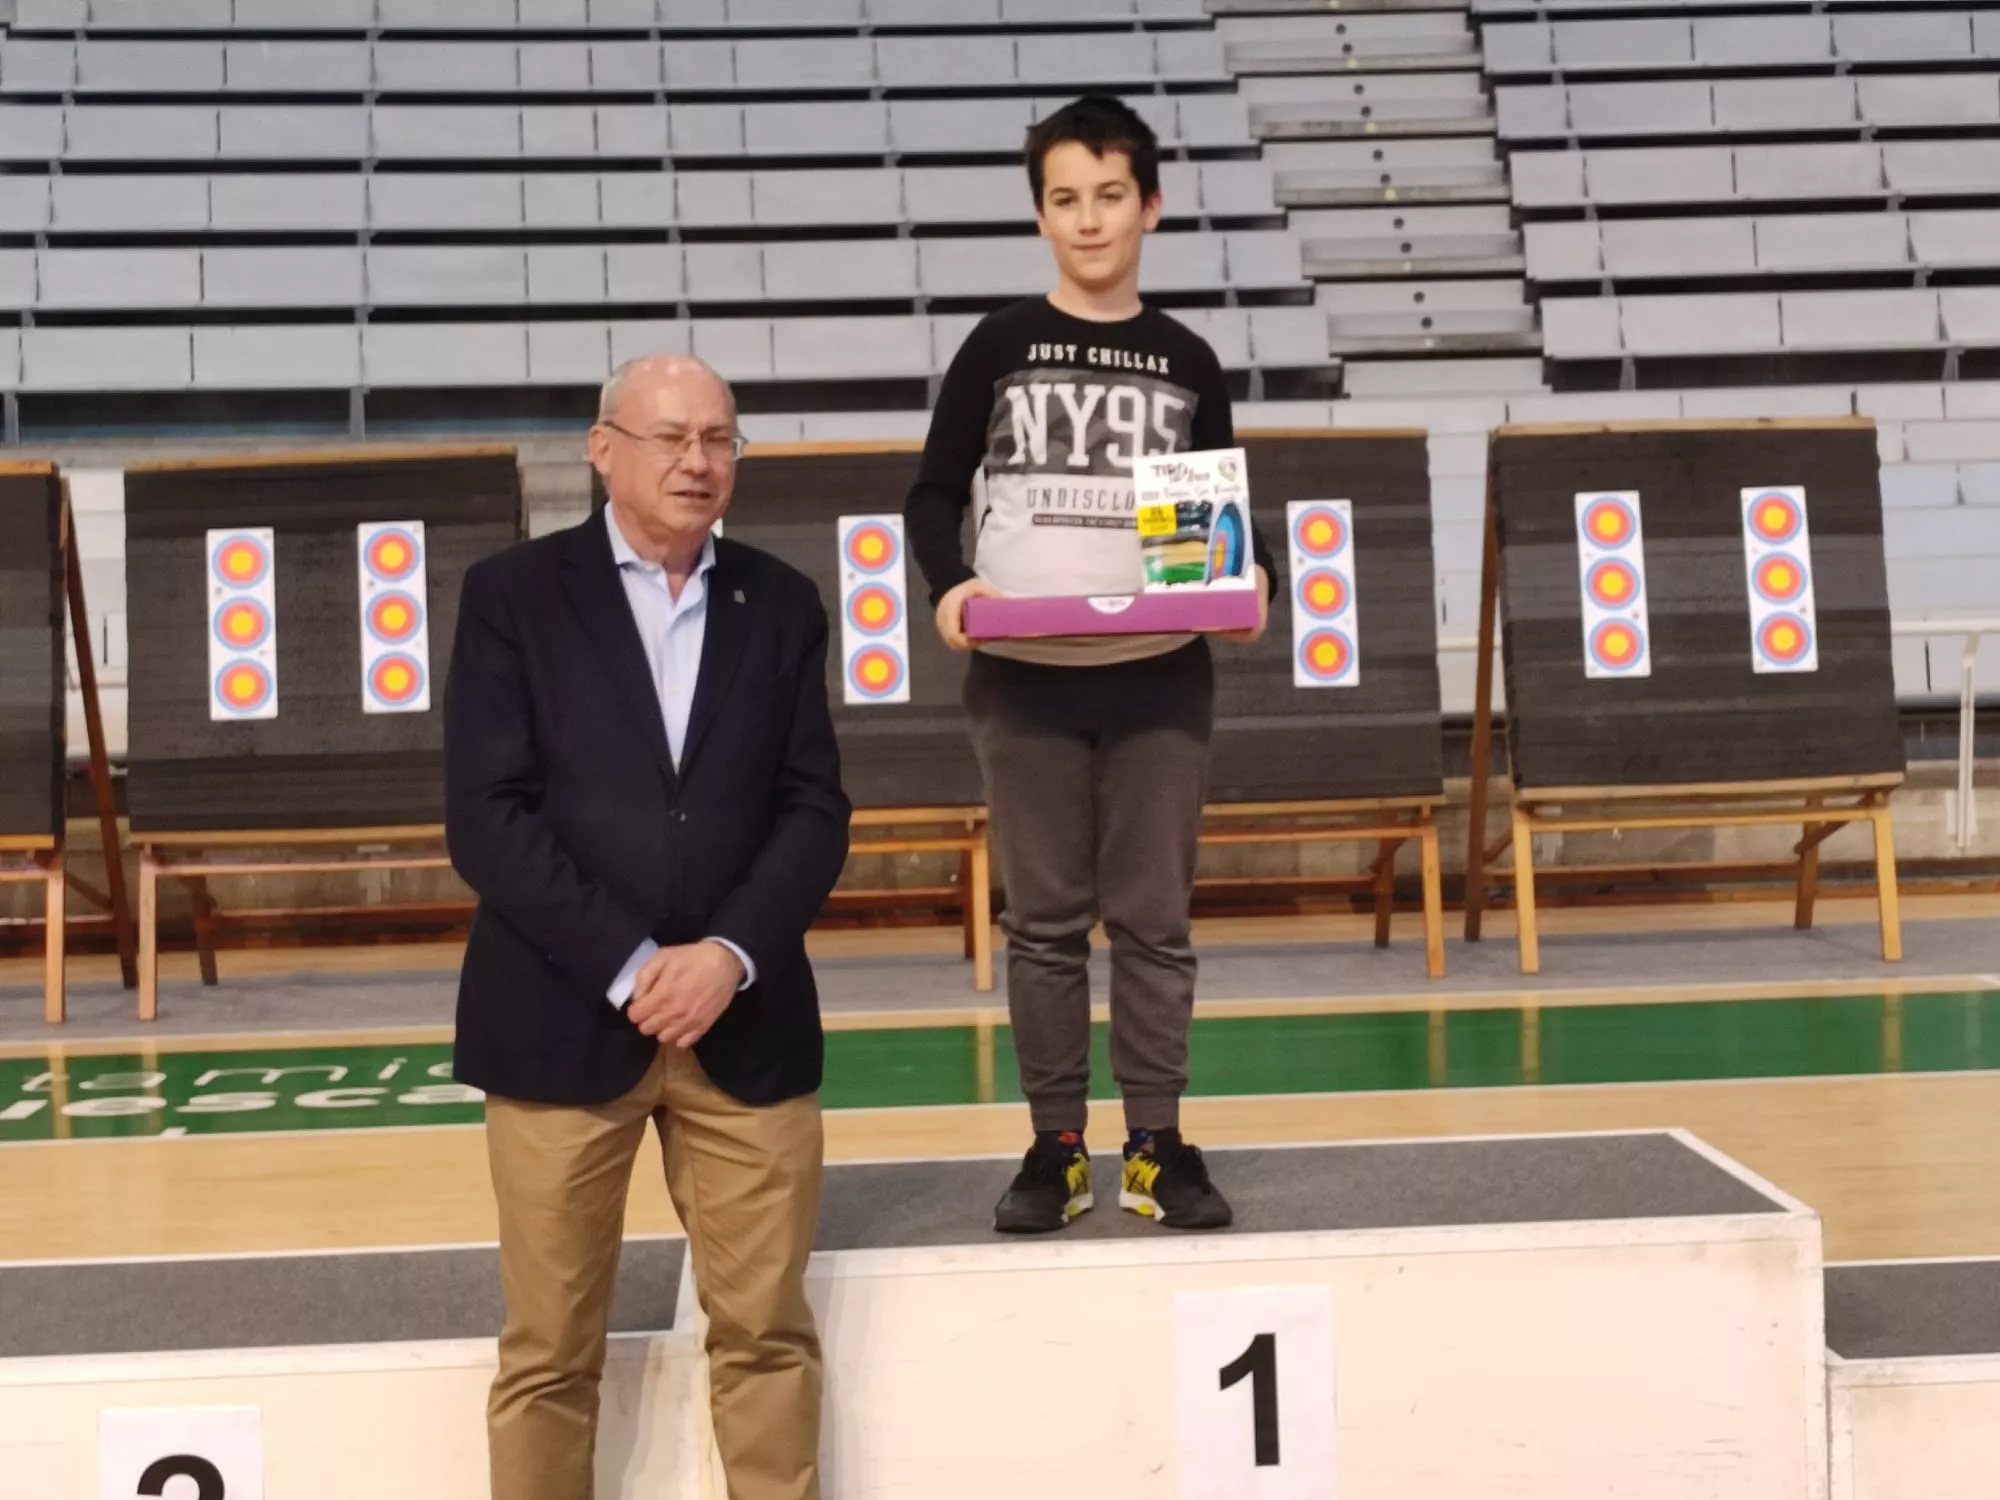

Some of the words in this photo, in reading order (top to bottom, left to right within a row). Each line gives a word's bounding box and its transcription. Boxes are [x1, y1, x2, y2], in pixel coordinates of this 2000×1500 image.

[1027, 343, 1078, 363] JUST
[1087, 346, 1170, 375] CHILLAX
[1005, 382, 1186, 468] NY95
[1219, 1332, 1281, 1467] 1
